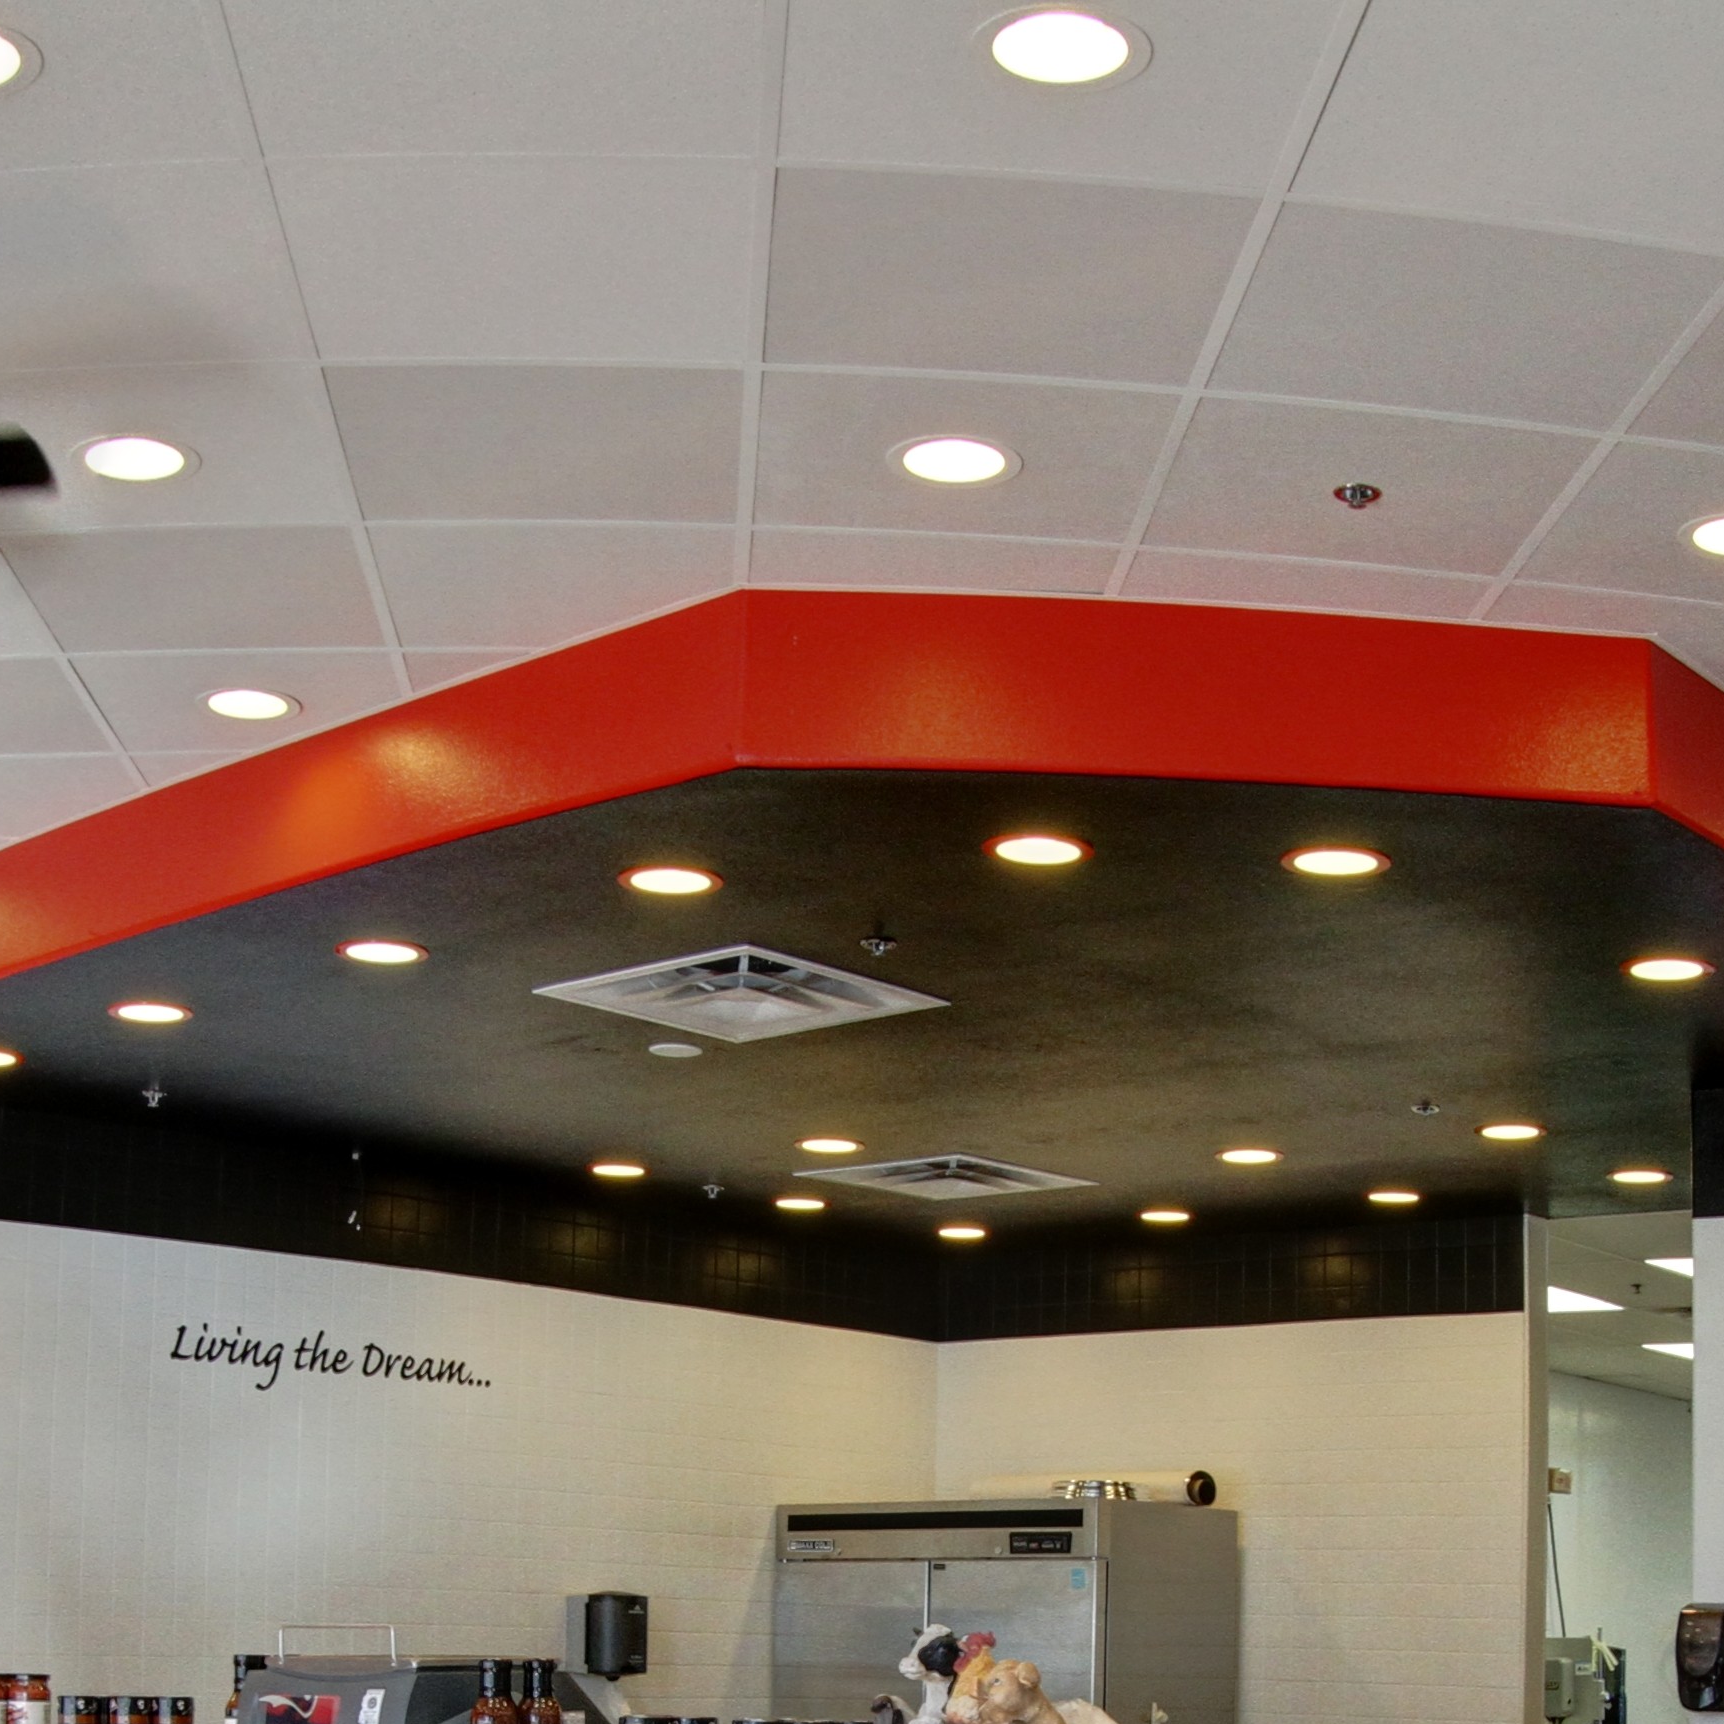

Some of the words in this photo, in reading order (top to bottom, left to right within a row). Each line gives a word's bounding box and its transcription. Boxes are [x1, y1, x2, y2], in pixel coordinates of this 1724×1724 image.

[170, 1322, 284, 1390] Living
[294, 1330, 353, 1374] the
[362, 1342, 491, 1388] Dream...
